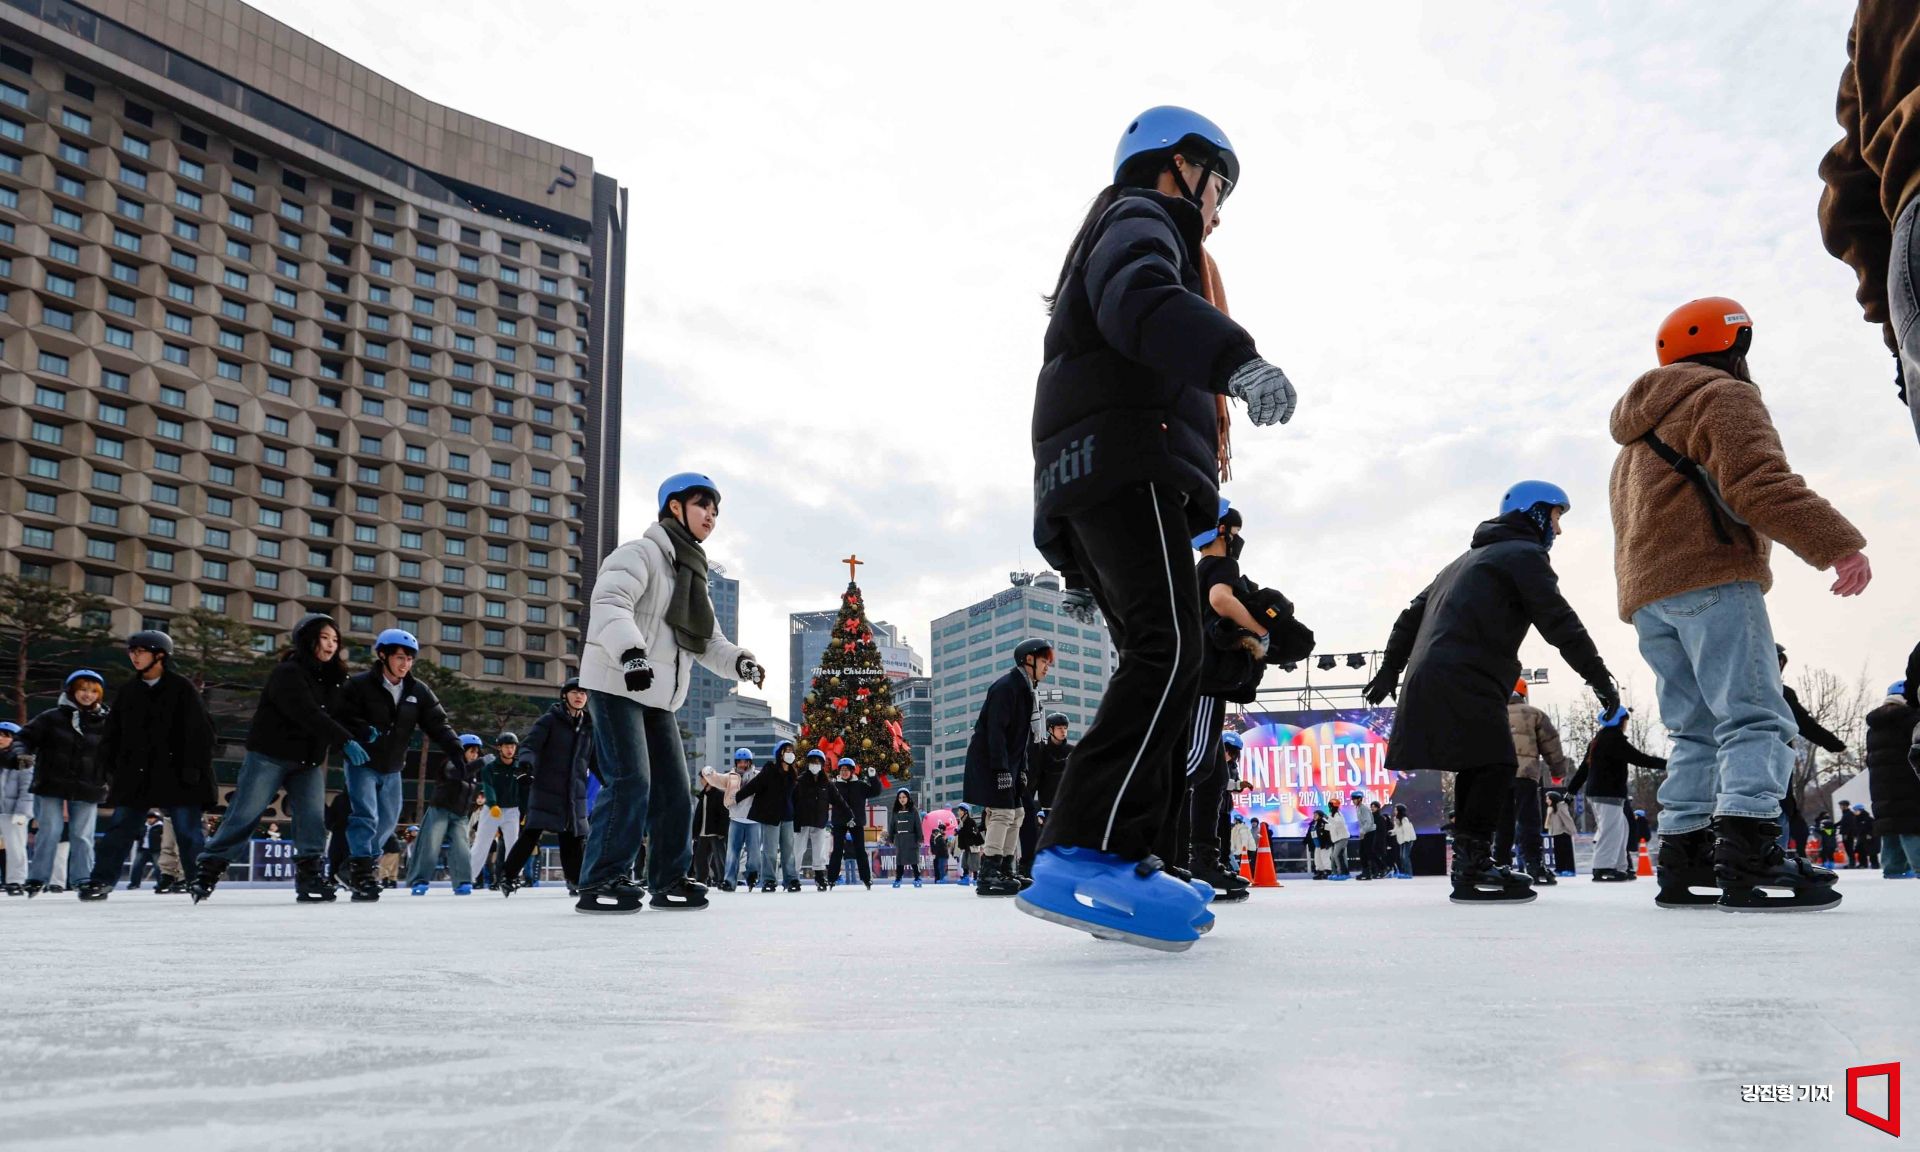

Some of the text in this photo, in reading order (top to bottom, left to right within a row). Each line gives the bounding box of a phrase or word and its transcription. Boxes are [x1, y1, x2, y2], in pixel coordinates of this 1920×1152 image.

[810, 667, 842, 677] Merry
[1319, 743, 1391, 787] FESTA
[264, 843, 299, 858] 203
